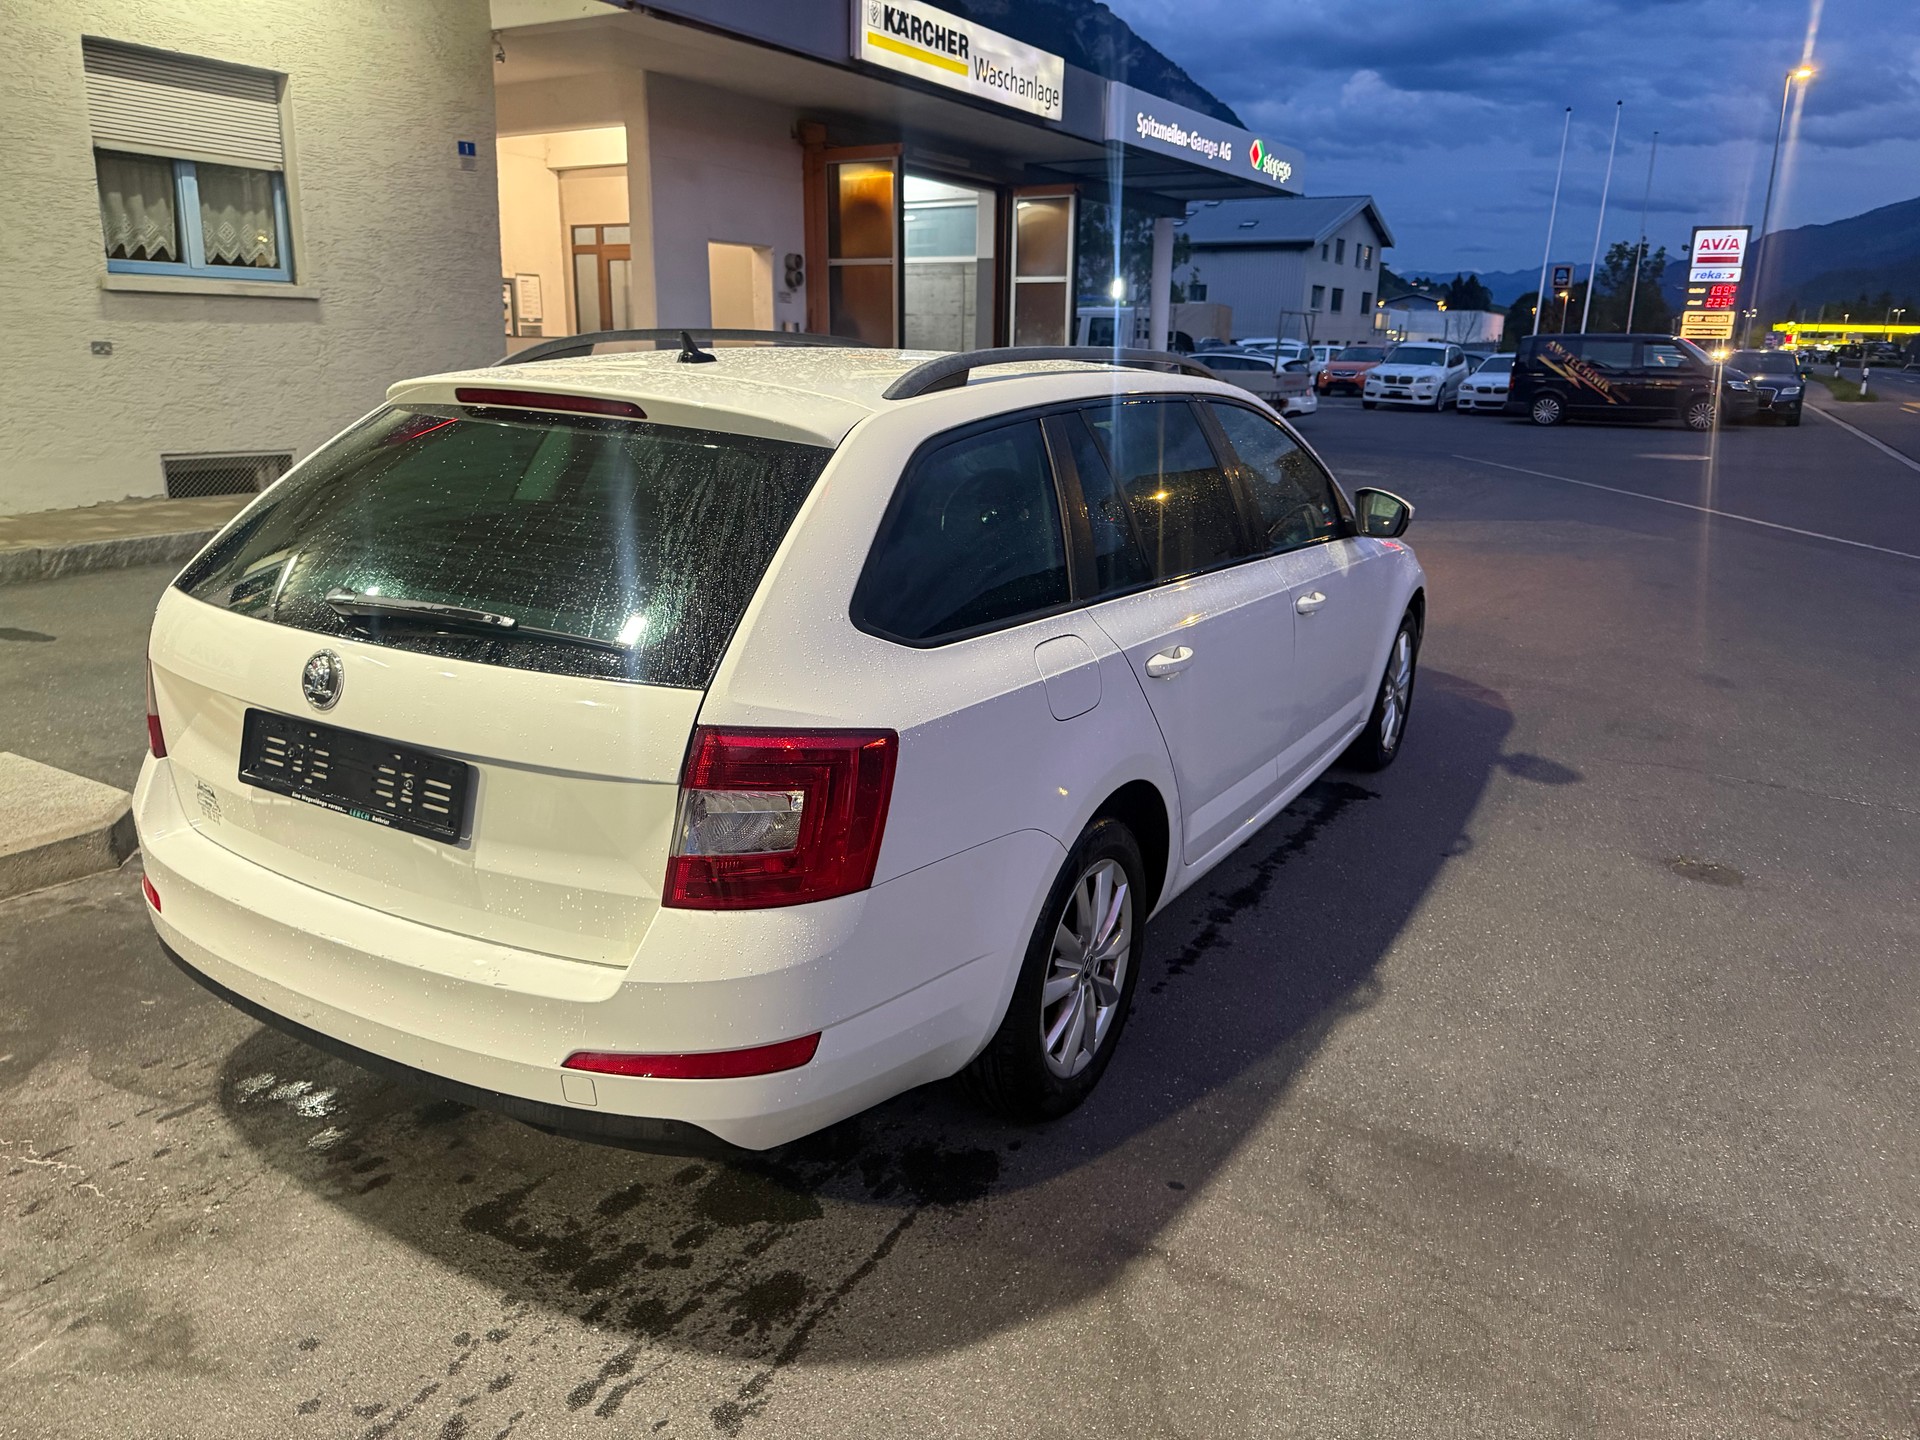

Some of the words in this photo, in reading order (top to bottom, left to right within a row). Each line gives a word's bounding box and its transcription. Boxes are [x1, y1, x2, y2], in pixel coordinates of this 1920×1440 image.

[883, 4, 969, 60] KÄRCHER
[973, 55, 1060, 110] Waschanlage
[1136, 112, 1219, 160] Spitzmeilen-Garage
[1219, 141, 1232, 161] AG
